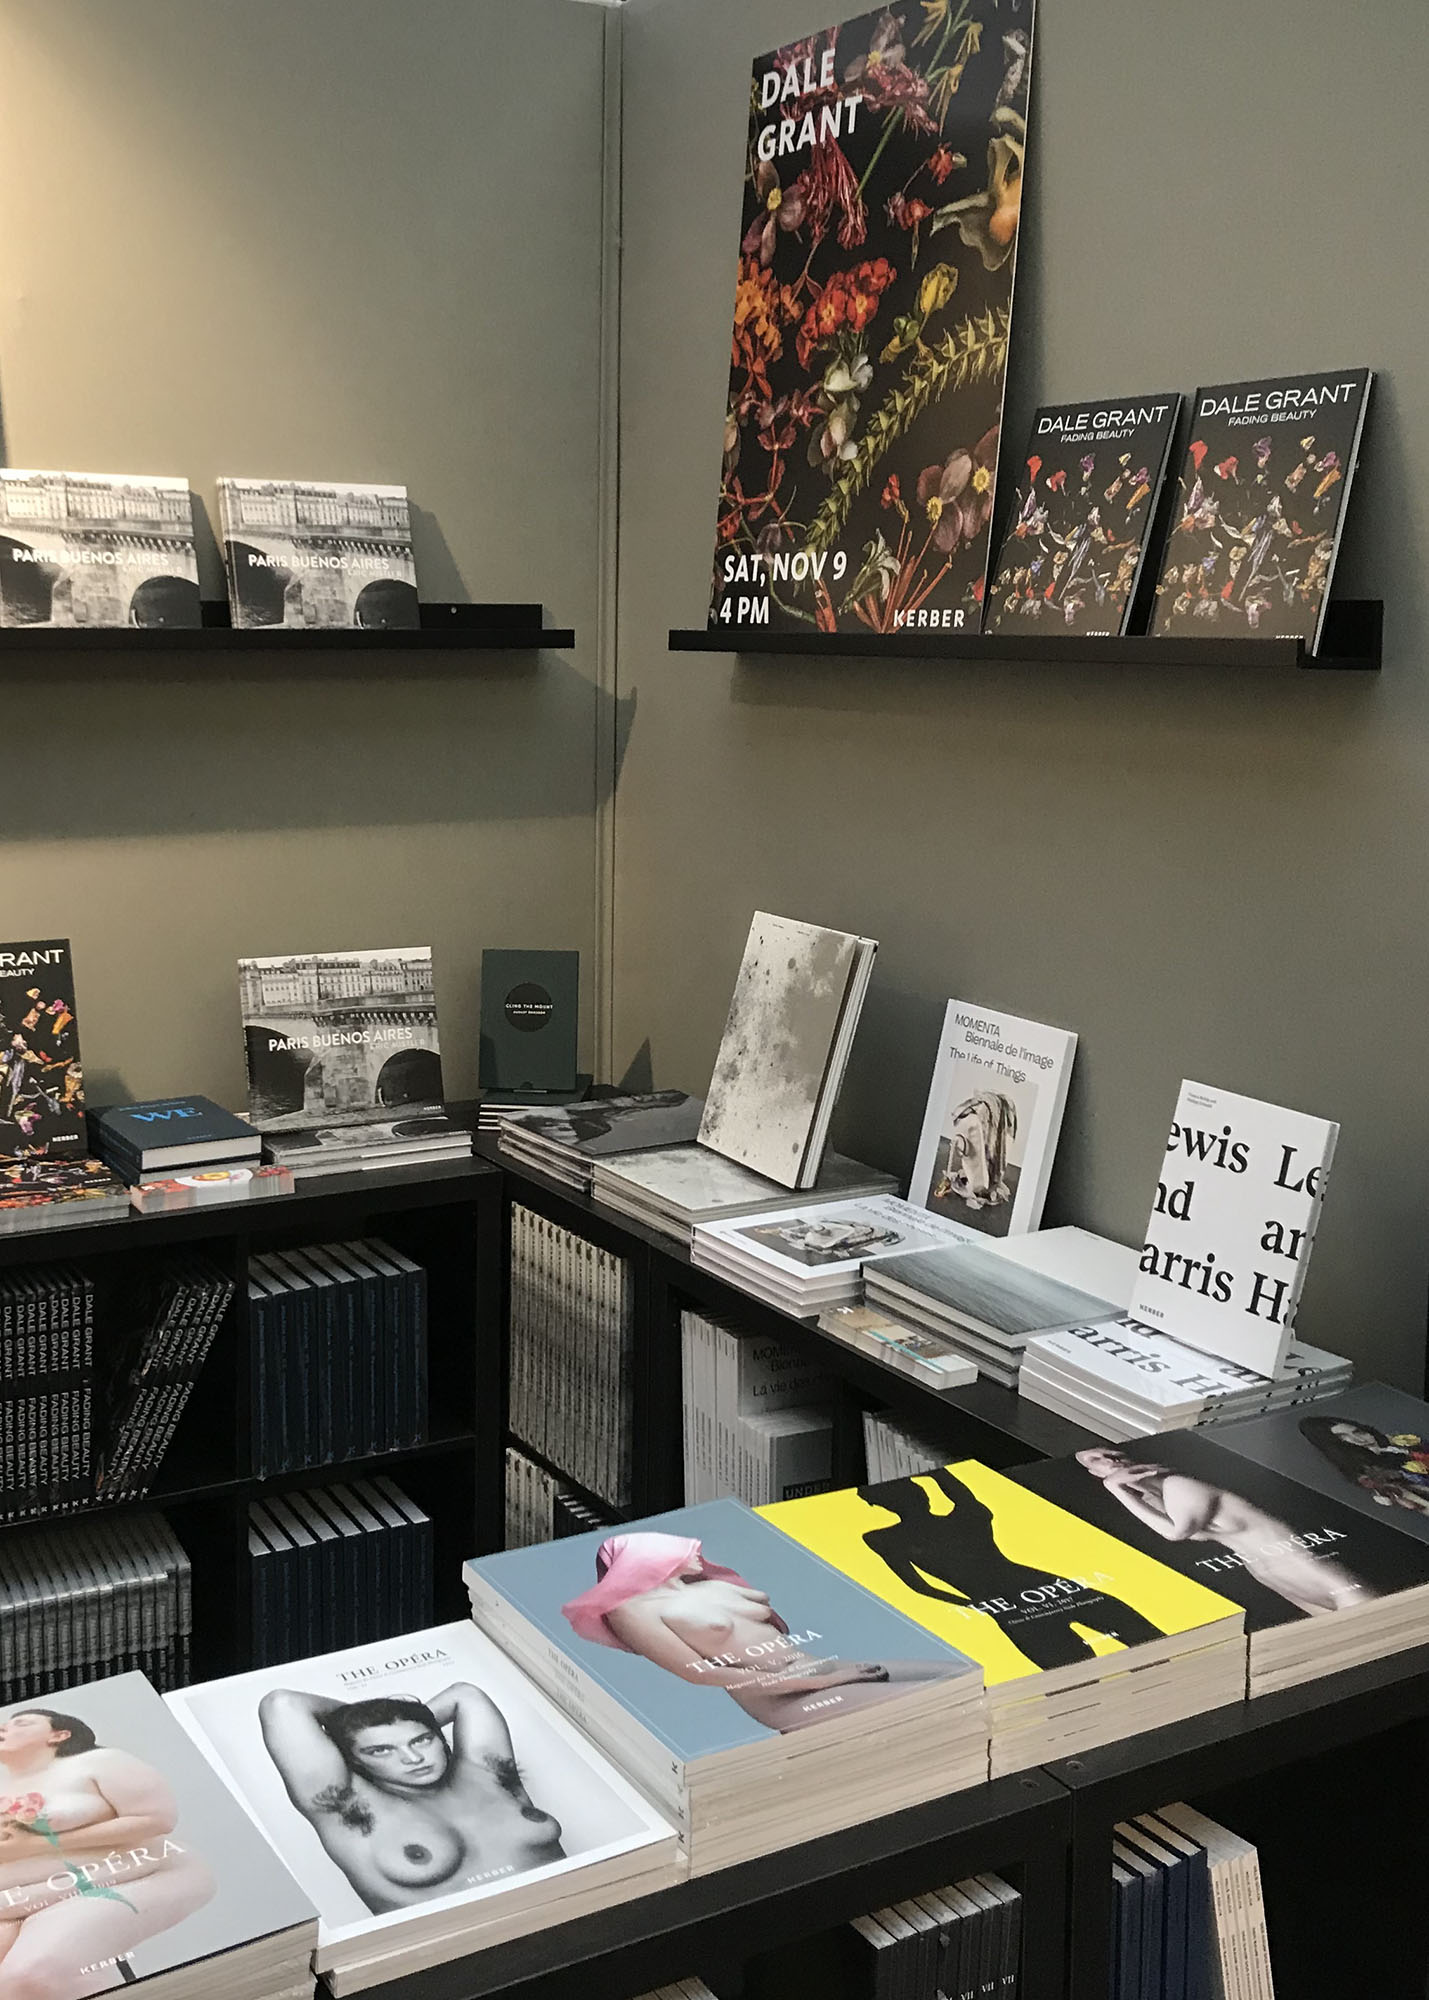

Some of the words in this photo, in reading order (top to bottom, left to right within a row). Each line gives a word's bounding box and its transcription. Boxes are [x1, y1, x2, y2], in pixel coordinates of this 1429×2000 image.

[761, 48, 836, 109] DALE
[757, 94, 863, 161] GRANT
[1037, 413, 1090, 435] DALE
[1092, 405, 1169, 431] GRANT
[1200, 392, 1263, 417] DALE
[1265, 384, 1357, 410] GRANT
[1228, 413, 1268, 427] FADING
[1270, 409, 1317, 423] BEAUTY
[1060, 430, 1095, 443] FADING
[1096, 428, 1135, 440] BEAUTY
[12, 548, 57, 563] PARIS
[60, 550, 122, 565] BUENOS
[127, 553, 170, 567] AIRES
[248, 554, 289, 567] PARIS
[293, 556, 349, 569] BUENOS
[351, 557, 390, 570] AIRES
[723, 554, 766, 587] SAT,
[772, 551, 828, 582] NOV
[833, 551, 847, 581] 9
[719, 597, 732, 624] 4
[737, 597, 770, 624] PM
[893, 609, 965, 628] KERBER
[268, 1036, 309, 1051] PARIS
[313, 1030, 370, 1047] BUENOS
[373, 1026, 413, 1042] AIRES
[955, 1014, 1001, 1037] MOMENTA
[949, 1046, 966, 1060] The
[996, 1062, 1027, 1083] Things
[965, 1031, 1005, 1053] Biennale
[1005, 1043, 1018, 1057] de
[1019, 1046, 1054, 1070] l'image
[130, 1107, 203, 1122] WE
[1139, 1242, 1234, 1303] arris
[4, 1306, 12, 1336] DALE
[17, 1304, 25, 1335] DALE
[28, 1303, 36, 1333] DALE
[39, 1302, 47, 1331] DALE
[51, 1300, 59, 1330] DALE
[61, 1298, 69, 1328] DALE
[72, 1296, 81, 1327] DALE
[85, 1294, 94, 1324] DALE
[191, 1296, 209, 1325] DALE
[202, 1294, 219, 1324] DALE
[215, 1293, 232, 1323] DALE
[4, 1339, 12, 1379] GRANT
[17, 1337, 25, 1377] GRANT
[28, 1336, 36, 1375] GRANT
[39, 1334, 47, 1374] GRANT
[51, 1332, 59, 1372] GRANT
[61, 1331, 69, 1371] GRANT
[72, 1329, 81, 1368] GRANT
[85, 1327, 94, 1367] GRANT
[177, 1327, 195, 1366] GRANT
[187, 1326, 206, 1365] GRANT
[198, 1324, 218, 1363] GRANT
[82, 1387, 92, 1430] FADING
[150, 1385, 172, 1426] FADING
[160, 1383, 183, 1424] FADING
[172, 1381, 194, 1422] FADING
[753, 1384, 768, 1397] La
[5, 1400, 14, 1443] FADING
[18, 1398, 26, 1442] FADING
[28, 1397, 37, 1440] FADING
[40, 1395, 48, 1438] FADING
[51, 1393, 60, 1437] FADING
[61, 1391, 70, 1434] FADING
[72, 1390, 80, 1432] FADING
[28, 1442, 37, 1488] BEAUTY
[40, 1440, 48, 1485] BEAUTY
[51, 1438, 60, 1483] BEAUTY
[61, 1436, 70, 1481] BEAUTY
[72, 1434, 80, 1479] BEAUTY
[82, 1431, 92, 1477] BEAUTY
[131, 1427, 154, 1472] BEAUTY
[142, 1425, 165, 1470] BEAUTY
[154, 1423, 176, 1468] BEAUTY
[5, 1445, 14, 1490] BEAUTY
[18, 1443, 26, 1488] BEAUTY
[1195, 1553, 1258, 1572] THE
[1259, 1526, 1348, 1556] OPÉRA
[950, 1597, 1018, 1621] THE
[1020, 1571, 1115, 1604] OPÉRA
[336, 1665, 379, 1682] THE
[385, 1648, 447, 1671] OPÉRA
[685, 1652, 741, 1673] THE
[745, 1629, 823, 1658] OPÉRA
[802, 1695, 844, 1712] KERBER
[47, 1839, 186, 1890] OPÉRA
[466, 1865, 515, 1884] KERBER
[80, 1951, 136, 1976] KERBER
